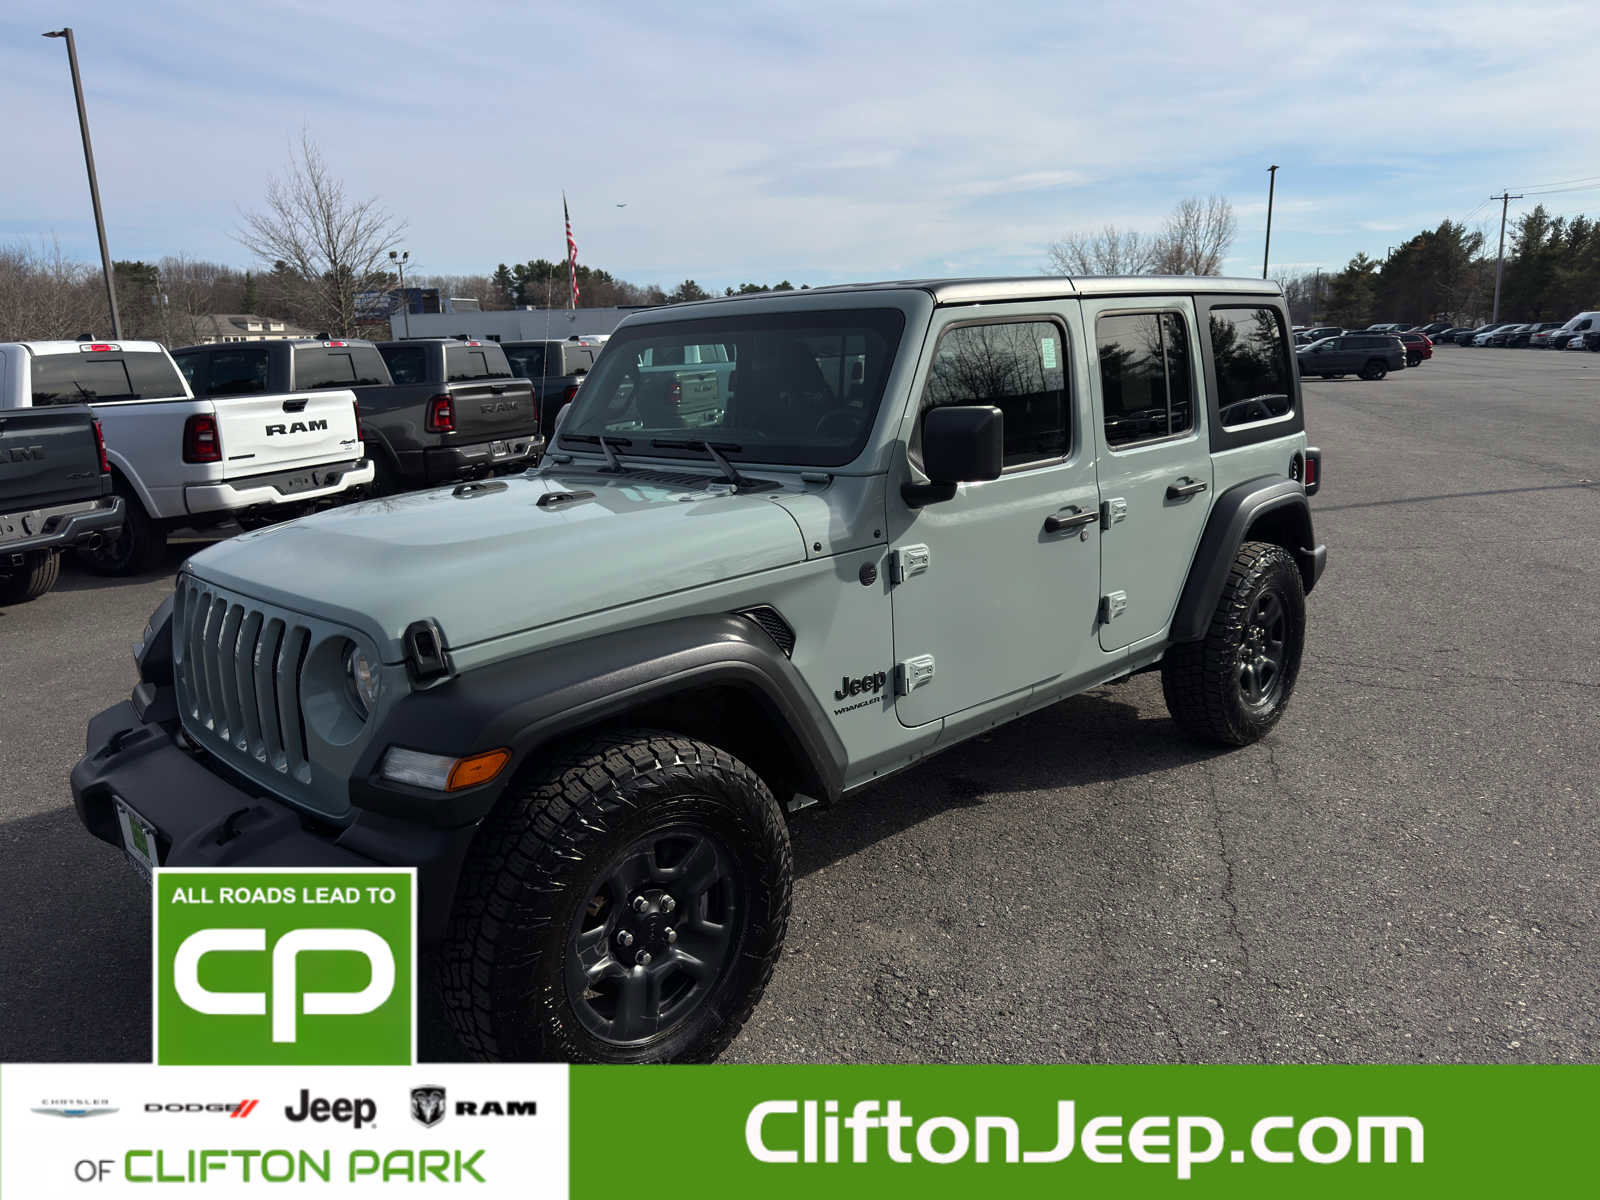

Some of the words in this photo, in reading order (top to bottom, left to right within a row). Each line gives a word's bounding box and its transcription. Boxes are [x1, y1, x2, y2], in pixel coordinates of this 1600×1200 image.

[265, 419, 328, 437] RAM
[834, 671, 886, 701] Jeep
[834, 696, 881, 716] WRANGLER
